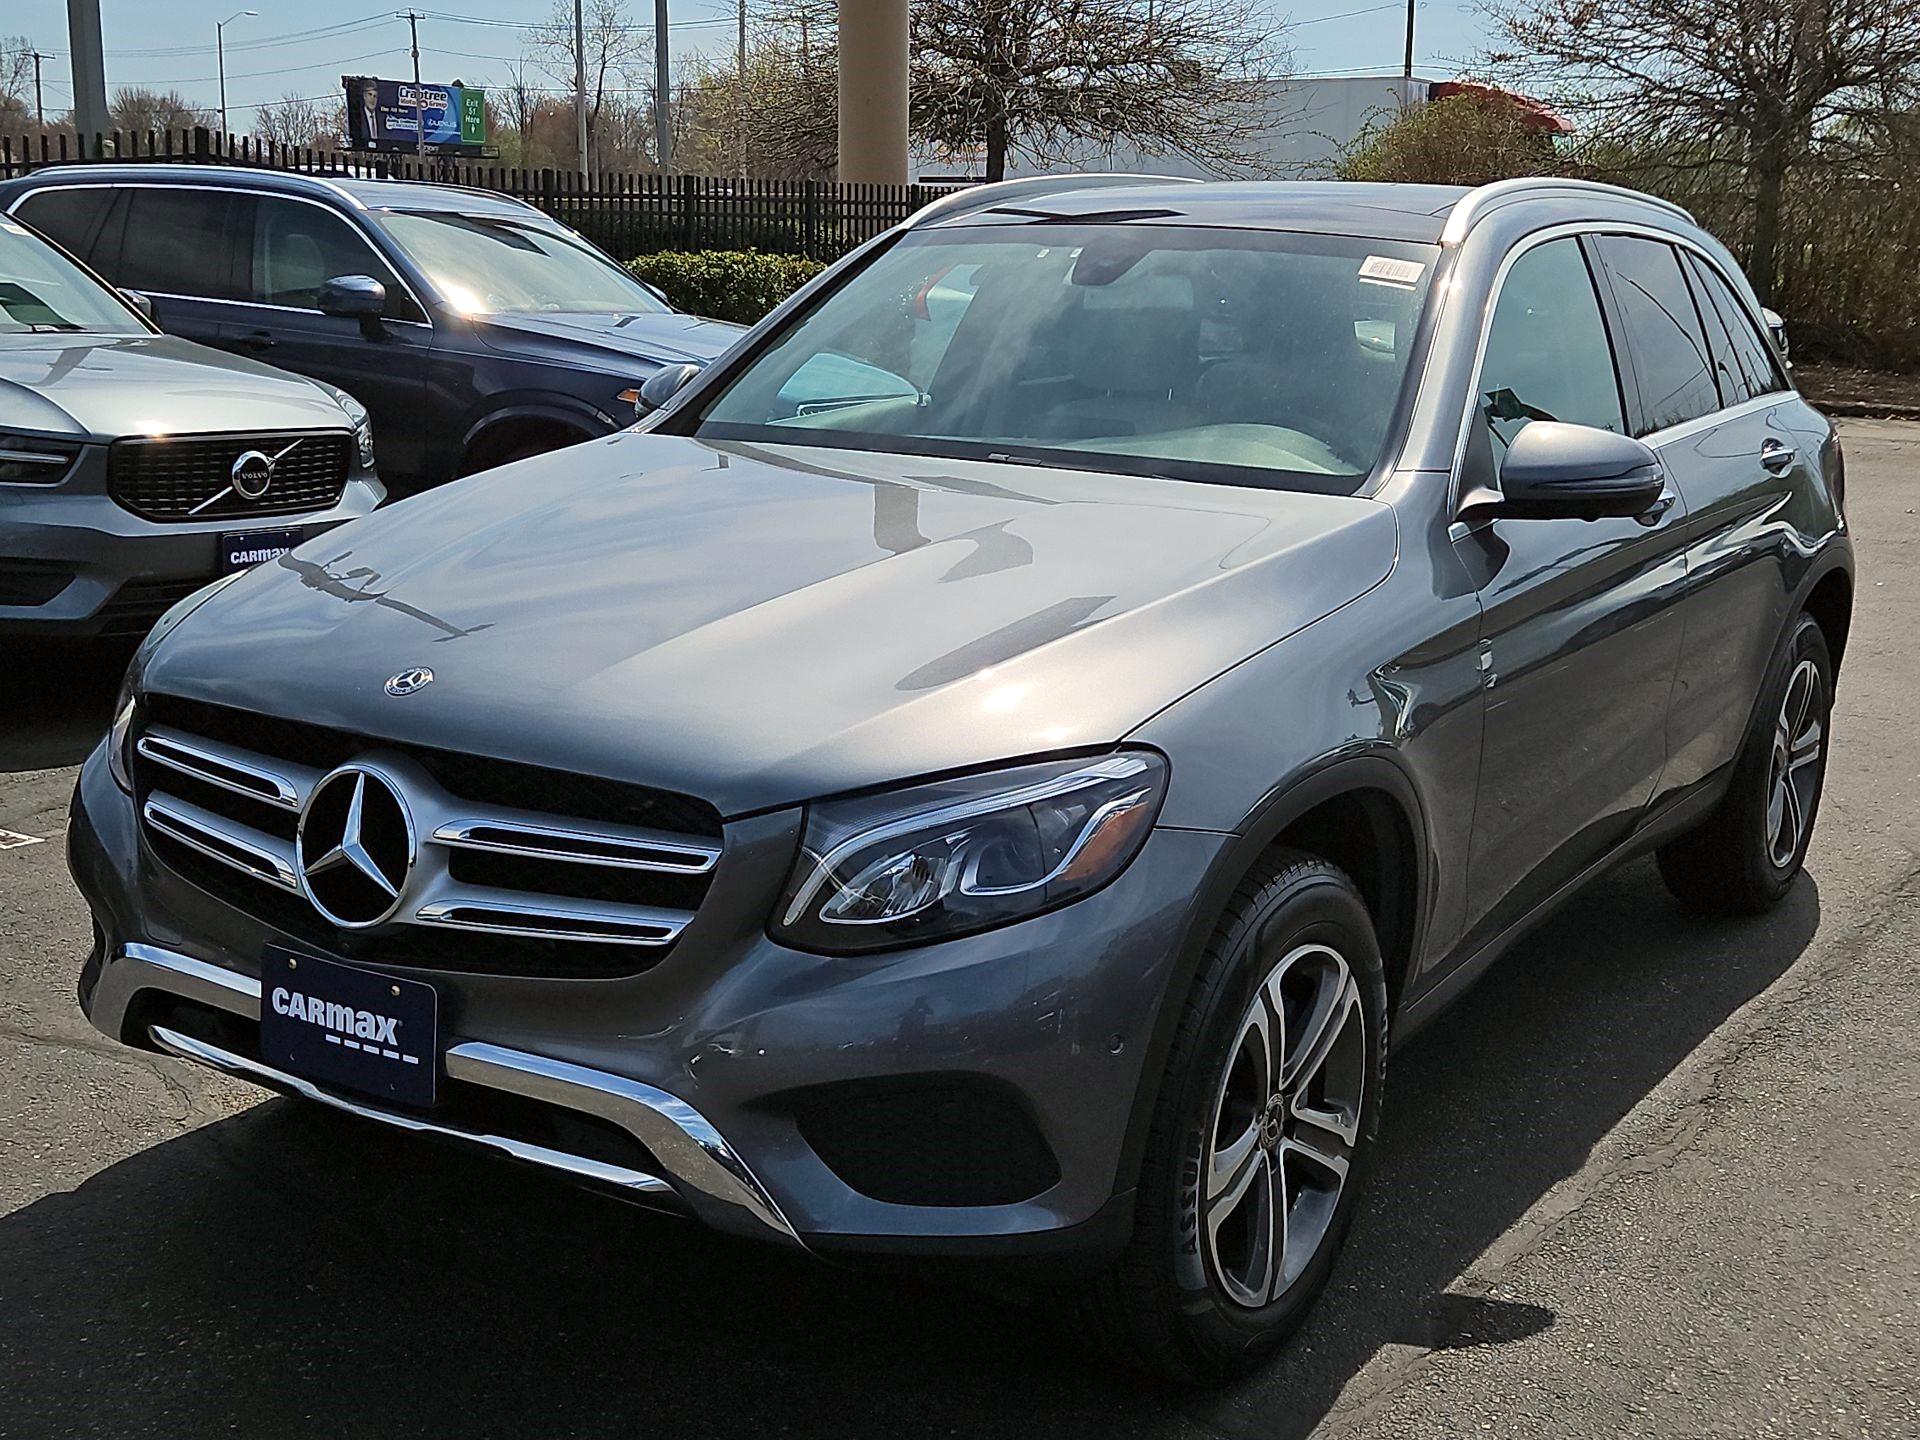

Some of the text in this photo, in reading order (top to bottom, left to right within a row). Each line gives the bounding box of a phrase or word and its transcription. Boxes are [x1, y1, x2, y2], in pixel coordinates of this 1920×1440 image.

[400, 86, 447, 101] Crabtree
[400, 97, 448, 109] Moto Group
[466, 98, 479, 107] Exit
[468, 107, 476, 115] 51
[465, 114, 480, 124] Here
[241, 472, 268, 480] VOLVO
[272, 986, 399, 1047] CARmax
